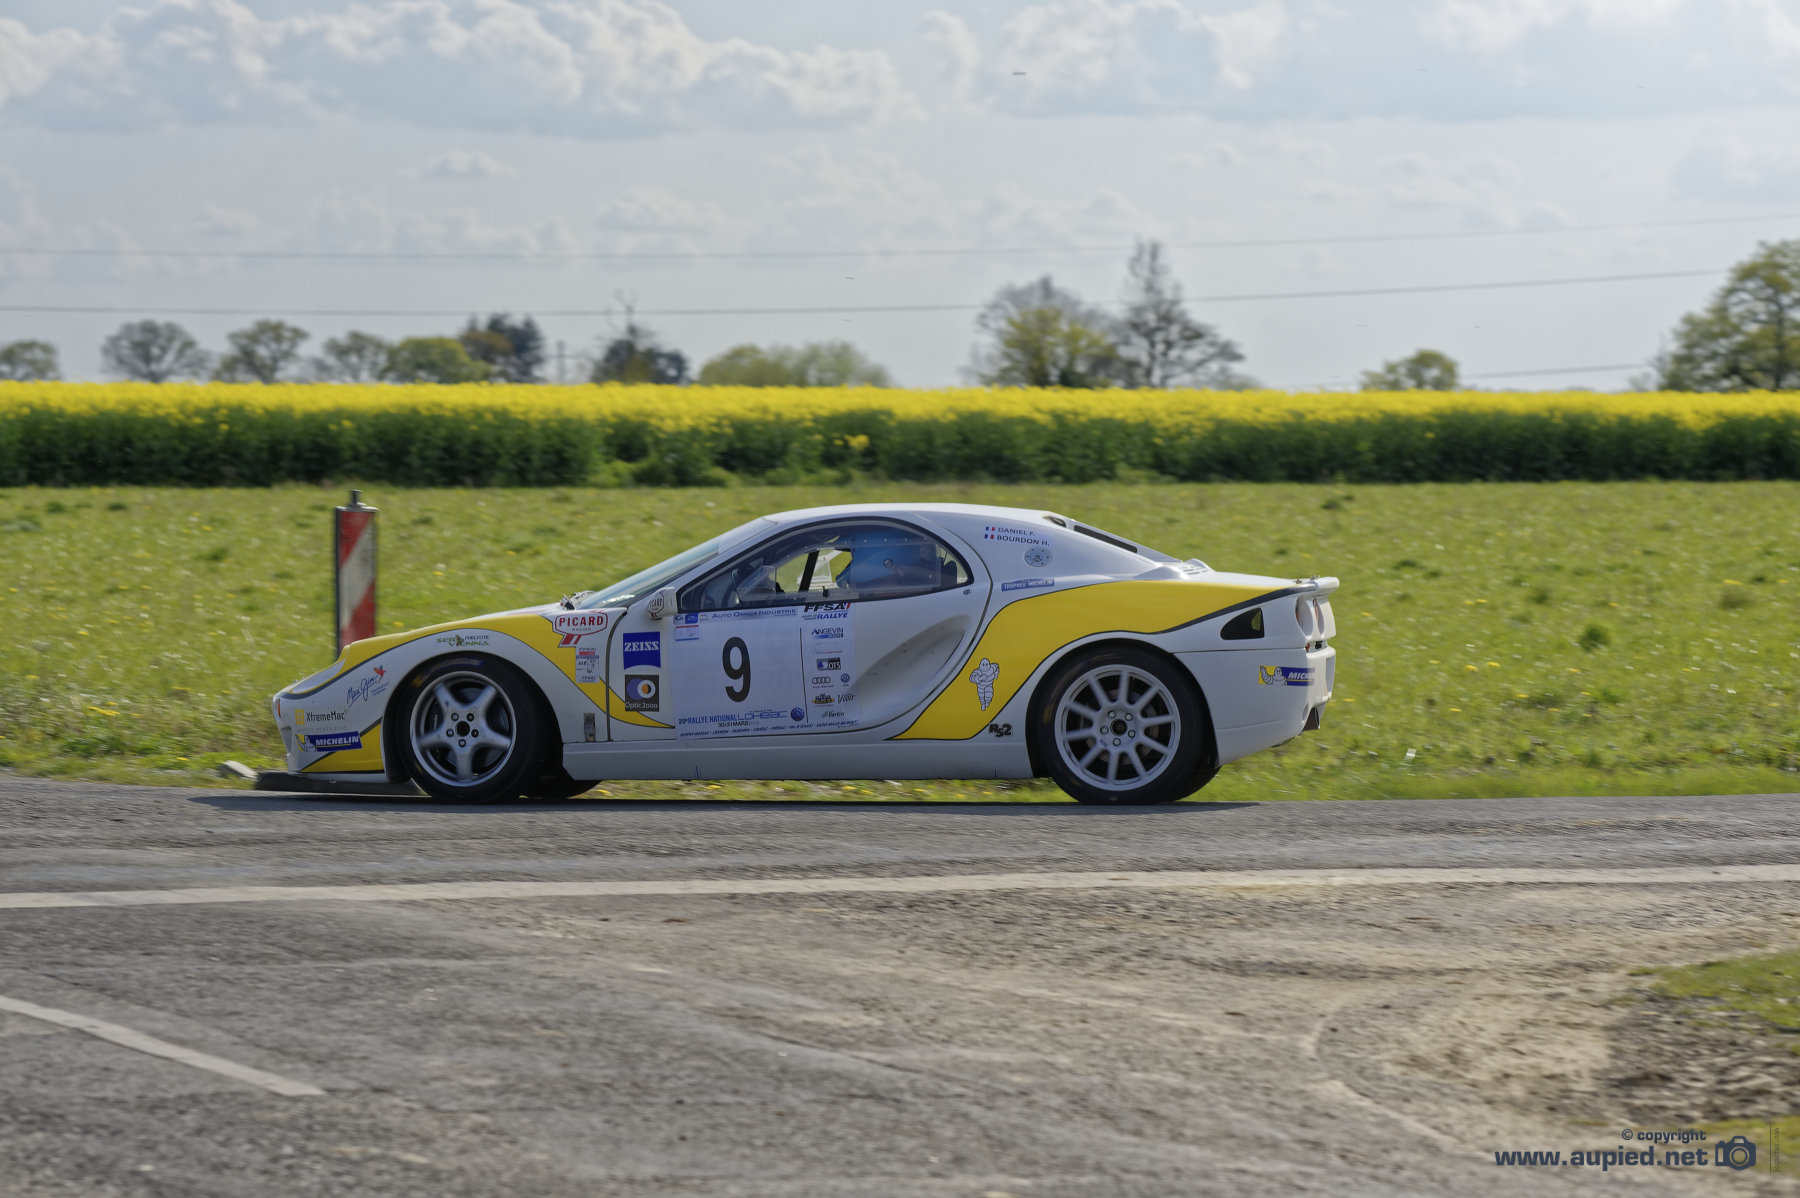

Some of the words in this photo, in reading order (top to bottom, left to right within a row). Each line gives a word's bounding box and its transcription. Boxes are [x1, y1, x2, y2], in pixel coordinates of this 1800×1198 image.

[997, 527, 1027, 536] DANIEL
[997, 535, 1039, 545] BOURDON
[559, 615, 604, 627] PICARD
[816, 612, 848, 620] RALLYE
[624, 641, 660, 652] ZEISS
[722, 636, 751, 703] 9
[315, 735, 359, 746] MICHELIN
